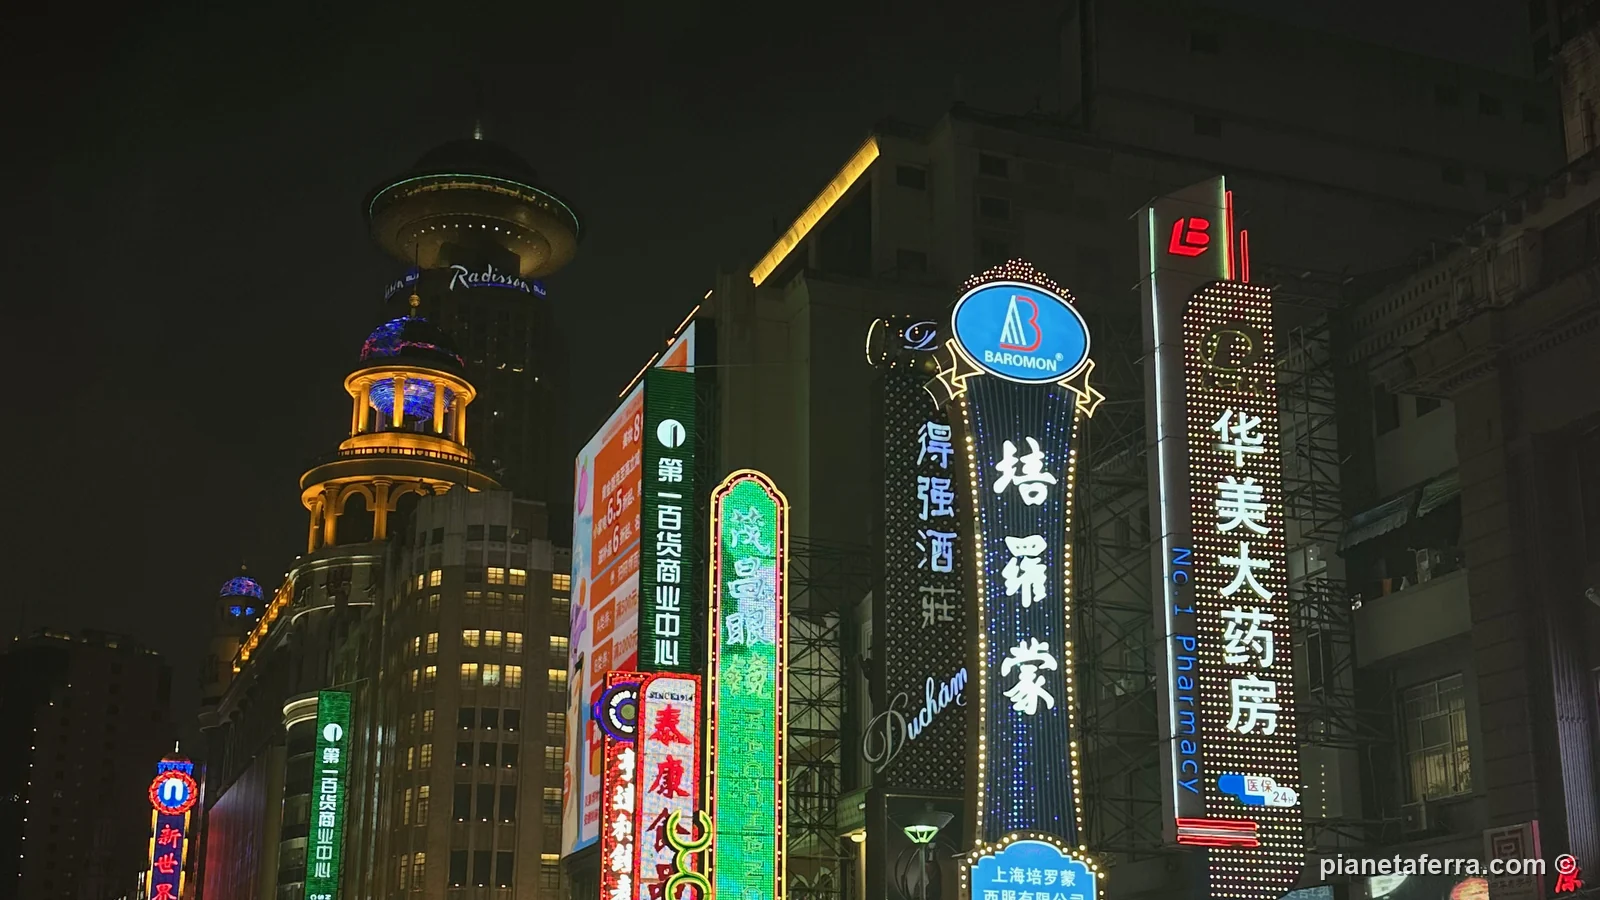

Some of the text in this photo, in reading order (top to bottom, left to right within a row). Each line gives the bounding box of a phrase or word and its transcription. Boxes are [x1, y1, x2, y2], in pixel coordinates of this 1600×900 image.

[449, 263, 531, 293] Radisson
[655, 457, 683, 666] 第一百货商业中心
[1212, 409, 1281, 736] 华美大药房
[1175, 635, 1200, 795] Pharmacy
[314, 747, 340, 878] 第一百货商业中心
[1247, 778, 1273, 793] 医保
[151, 824, 182, 900] 新世界
[991, 866, 1076, 887] 上海培罗蒙
